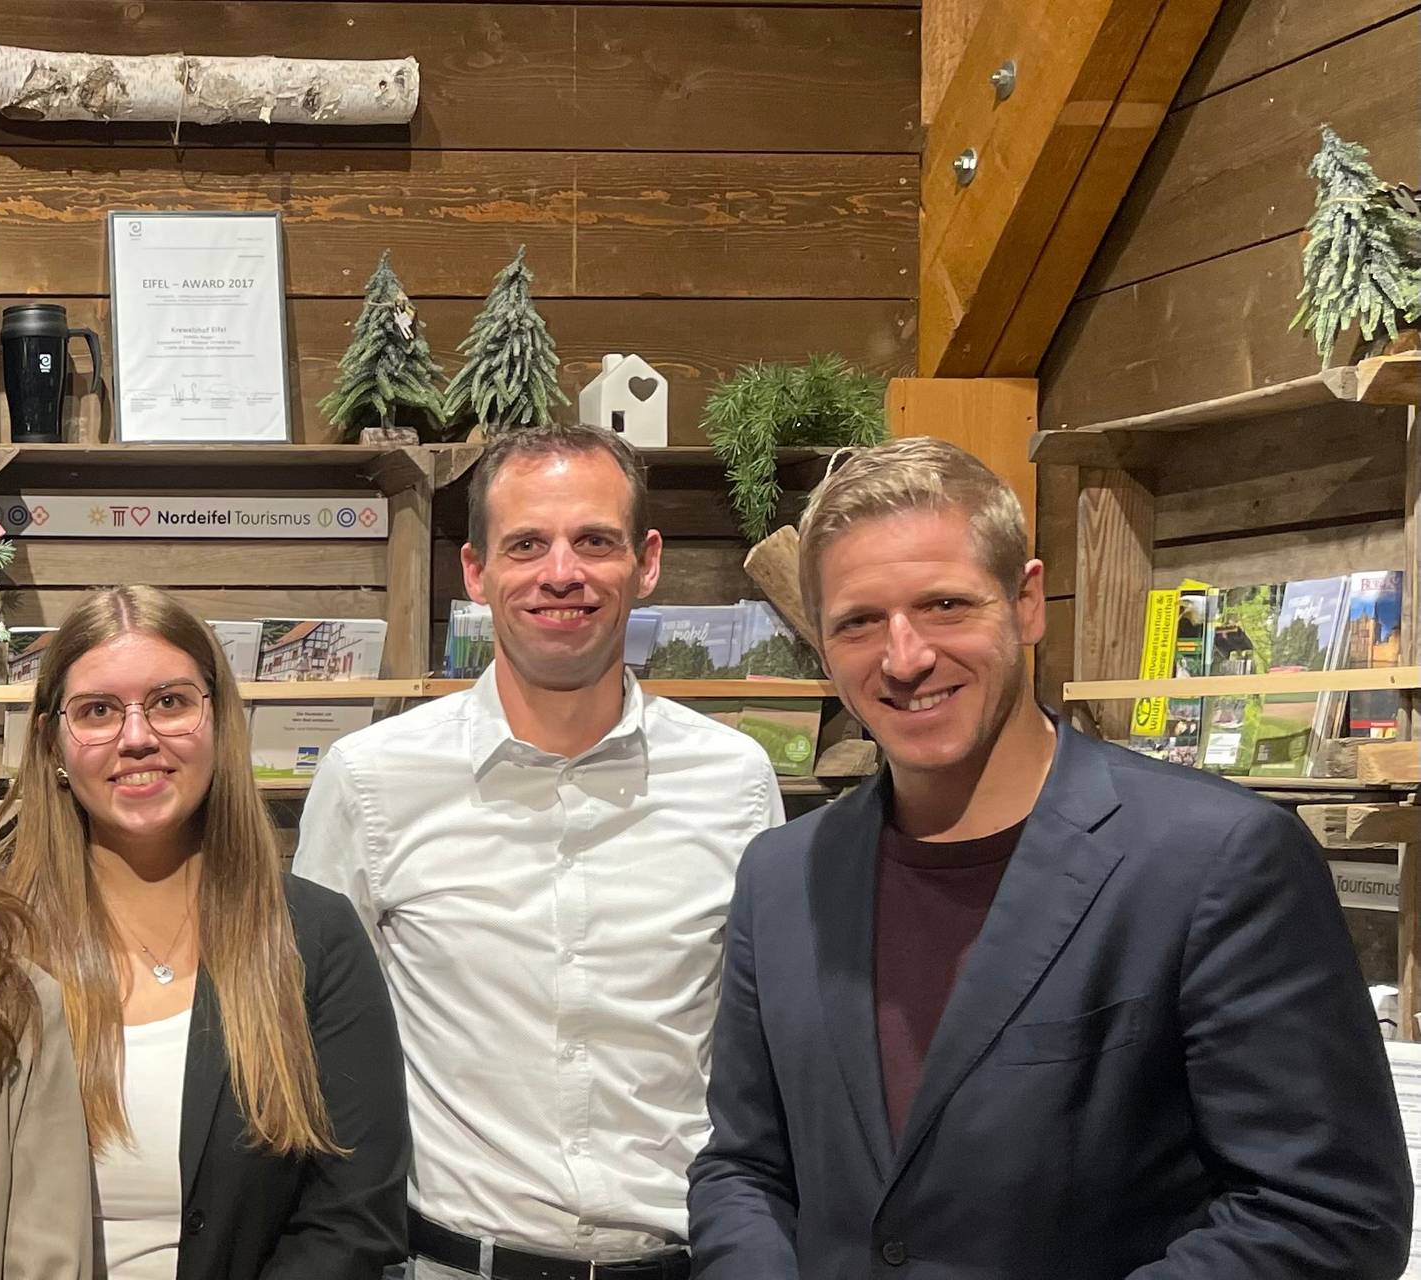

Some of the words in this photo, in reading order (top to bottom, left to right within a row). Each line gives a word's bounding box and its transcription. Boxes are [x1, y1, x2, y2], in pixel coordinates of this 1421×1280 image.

[142, 279, 169, 289] EIFEL
[182, 279, 225, 289] AWARD
[228, 278, 255, 289] 2017
[157, 510, 231, 525] Nordeifel
[234, 510, 311, 526] Tourismus
[1337, 875, 1401, 897] Tourismus
